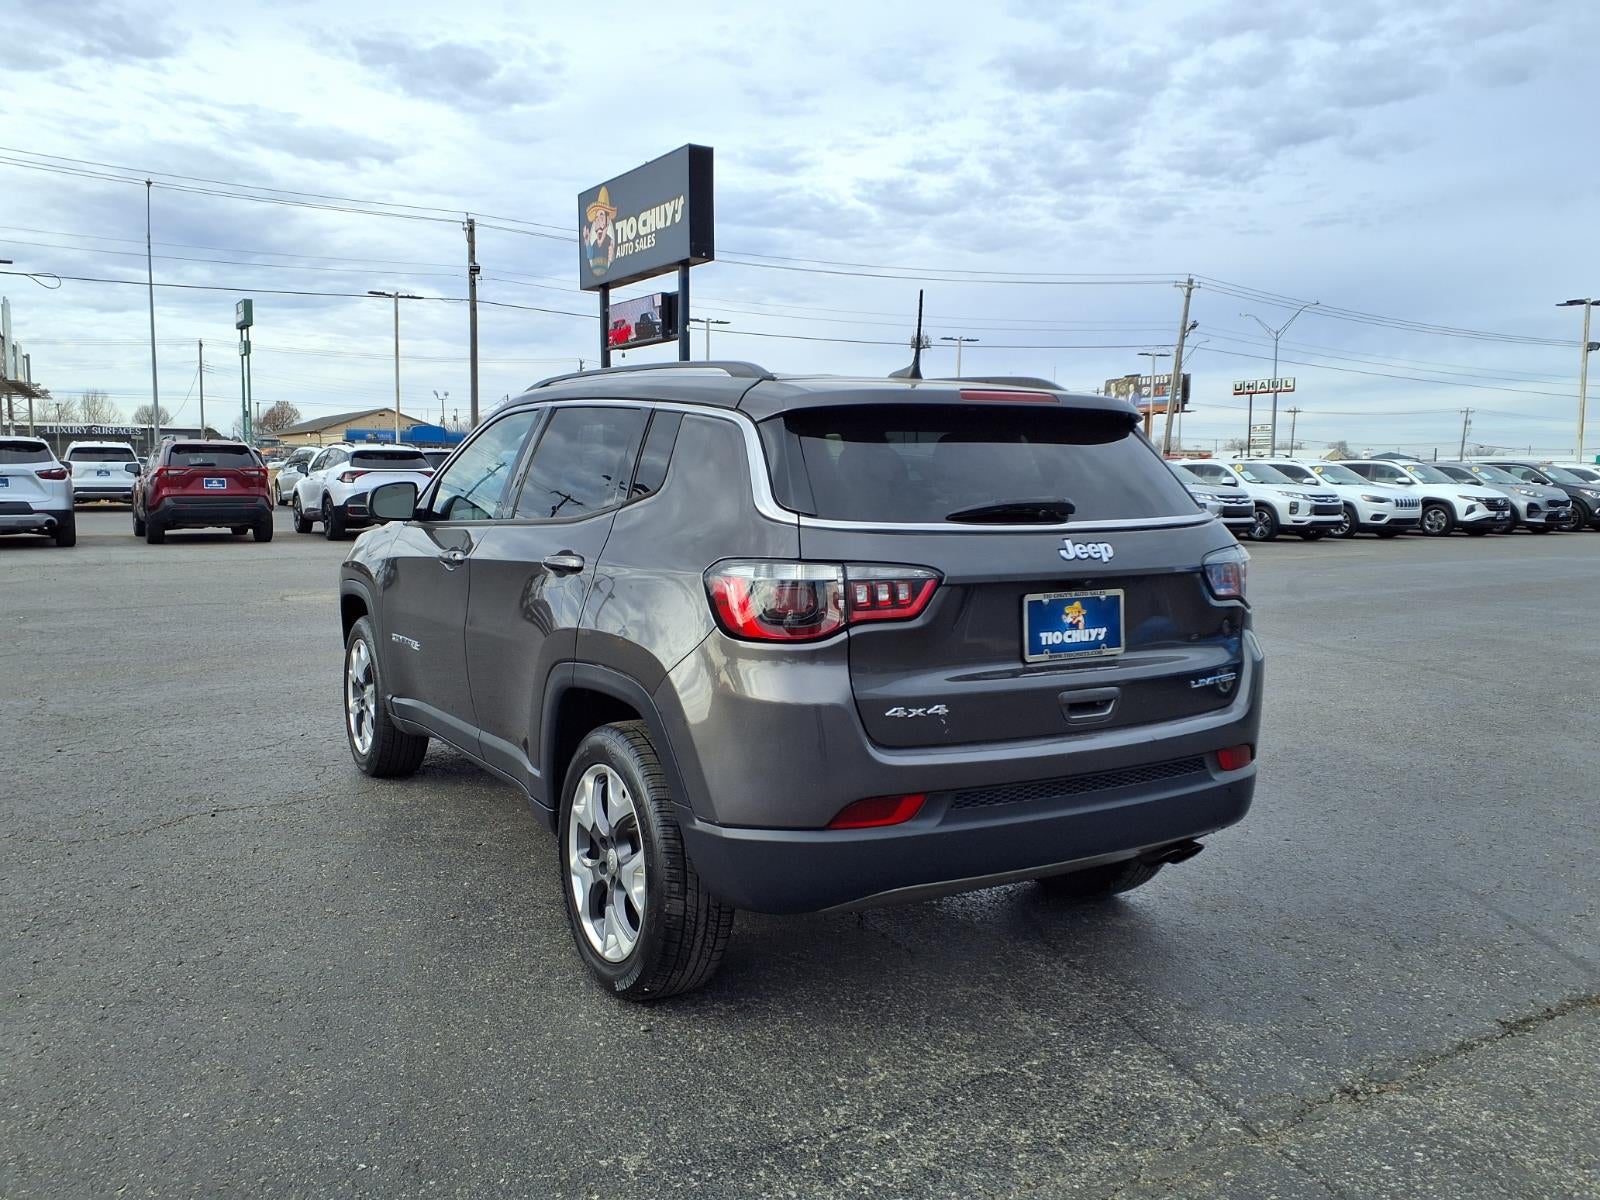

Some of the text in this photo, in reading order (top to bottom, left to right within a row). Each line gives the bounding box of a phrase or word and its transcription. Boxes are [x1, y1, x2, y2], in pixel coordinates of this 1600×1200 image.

[615, 194, 685, 244] TIO CHUY'S
[615, 233, 656, 259] AUTO SALES
[1138, 376, 1168, 385] THUDER
[46, 426, 141, 435] LUXURY SURFACES
[1059, 538, 1114, 563] Jeep
[1039, 626, 1107, 646] TIO CHUY'S
[884, 704, 949, 718] 4x4
